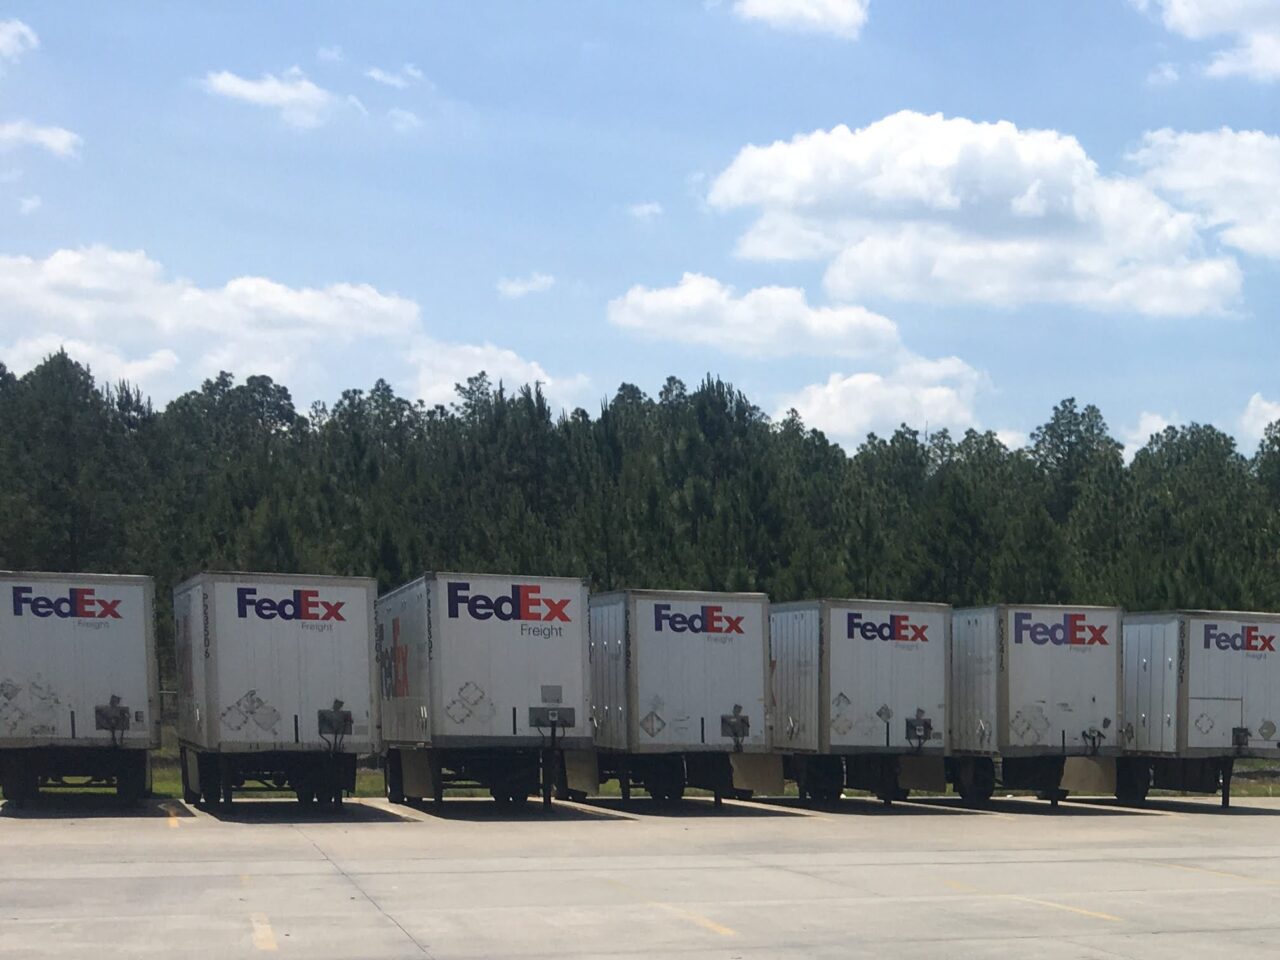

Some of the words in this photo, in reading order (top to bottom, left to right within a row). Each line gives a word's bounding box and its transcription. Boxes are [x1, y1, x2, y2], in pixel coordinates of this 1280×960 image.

[12, 586, 124, 618] FedEx
[237, 587, 346, 621] FedEx
[447, 582, 572, 622] FedEx
[301, 622, 333, 632] Freight
[520, 623, 562, 640] Freight
[654, 604, 744, 634] FedEx
[847, 613, 929, 643] FedEx
[1014, 612, 1109, 645] FedEx
[1204, 624, 1276, 651] FedEx
